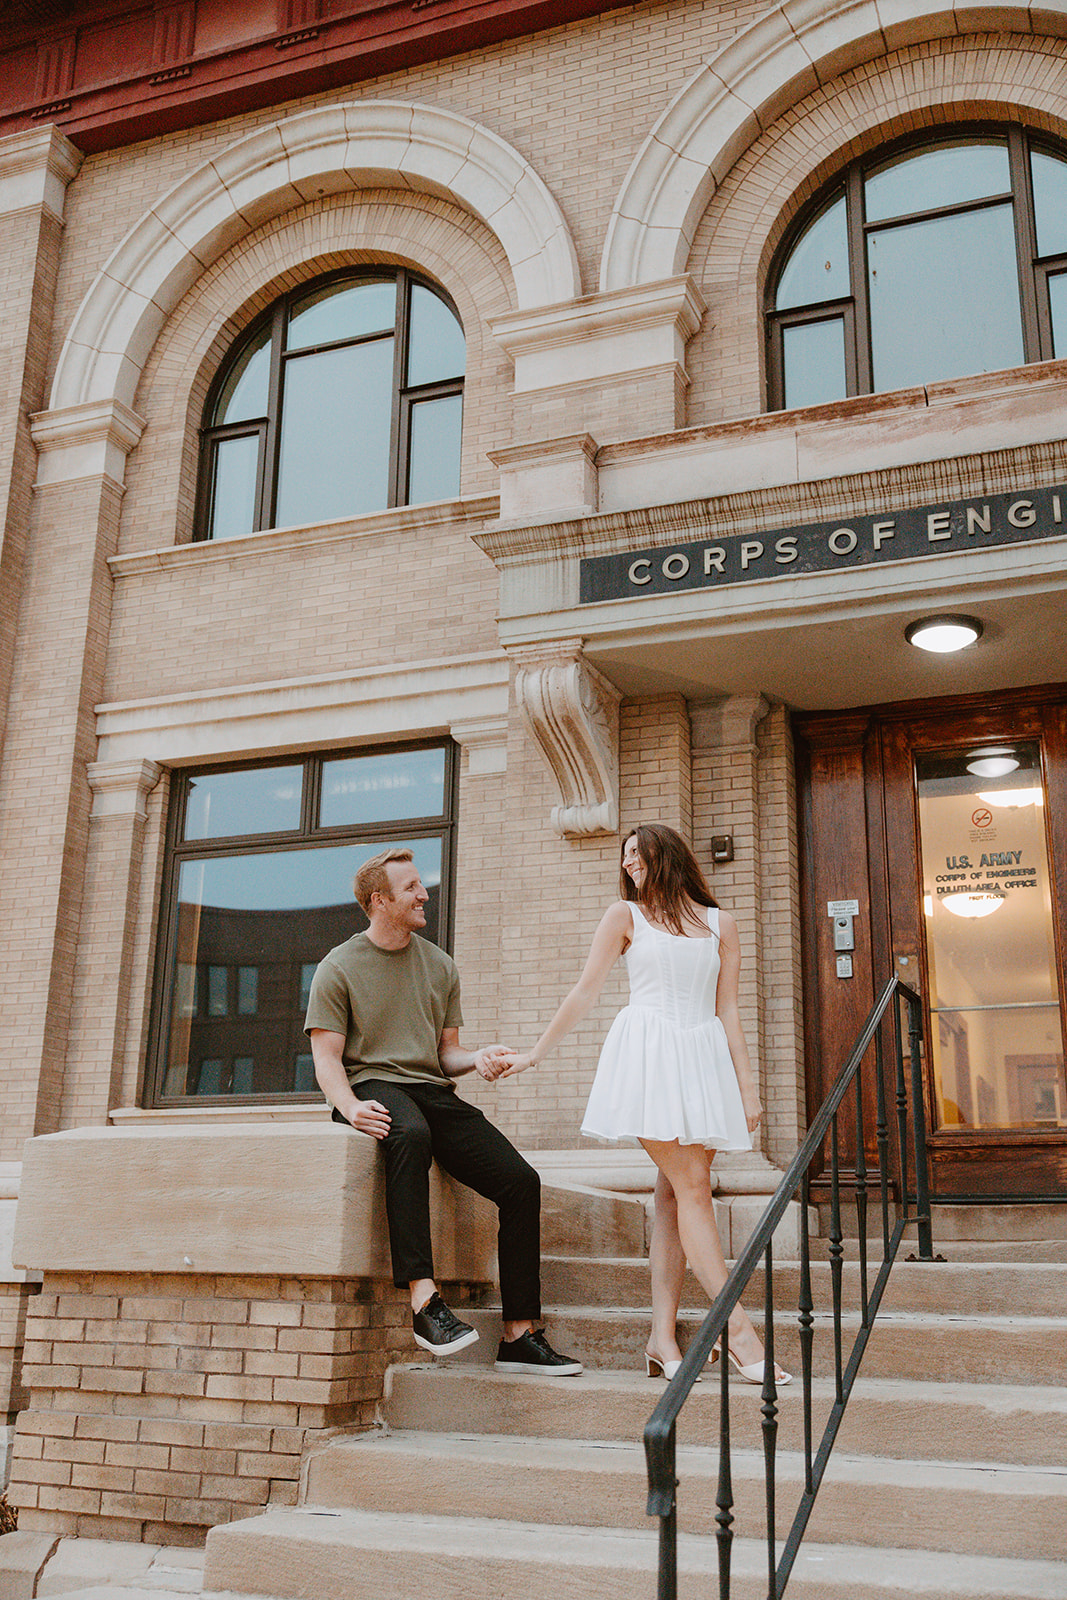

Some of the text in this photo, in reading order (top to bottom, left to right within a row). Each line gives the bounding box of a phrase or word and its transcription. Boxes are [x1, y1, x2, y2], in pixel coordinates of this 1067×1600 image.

[628, 495, 1062, 586] CORPS OF ENGI
[946, 850, 1022, 870] U.S. ARMY
[935, 868, 1036, 882] CORPS OF ENGINEERS
[937, 879, 1037, 894] DULUTH AREA OFFICE
